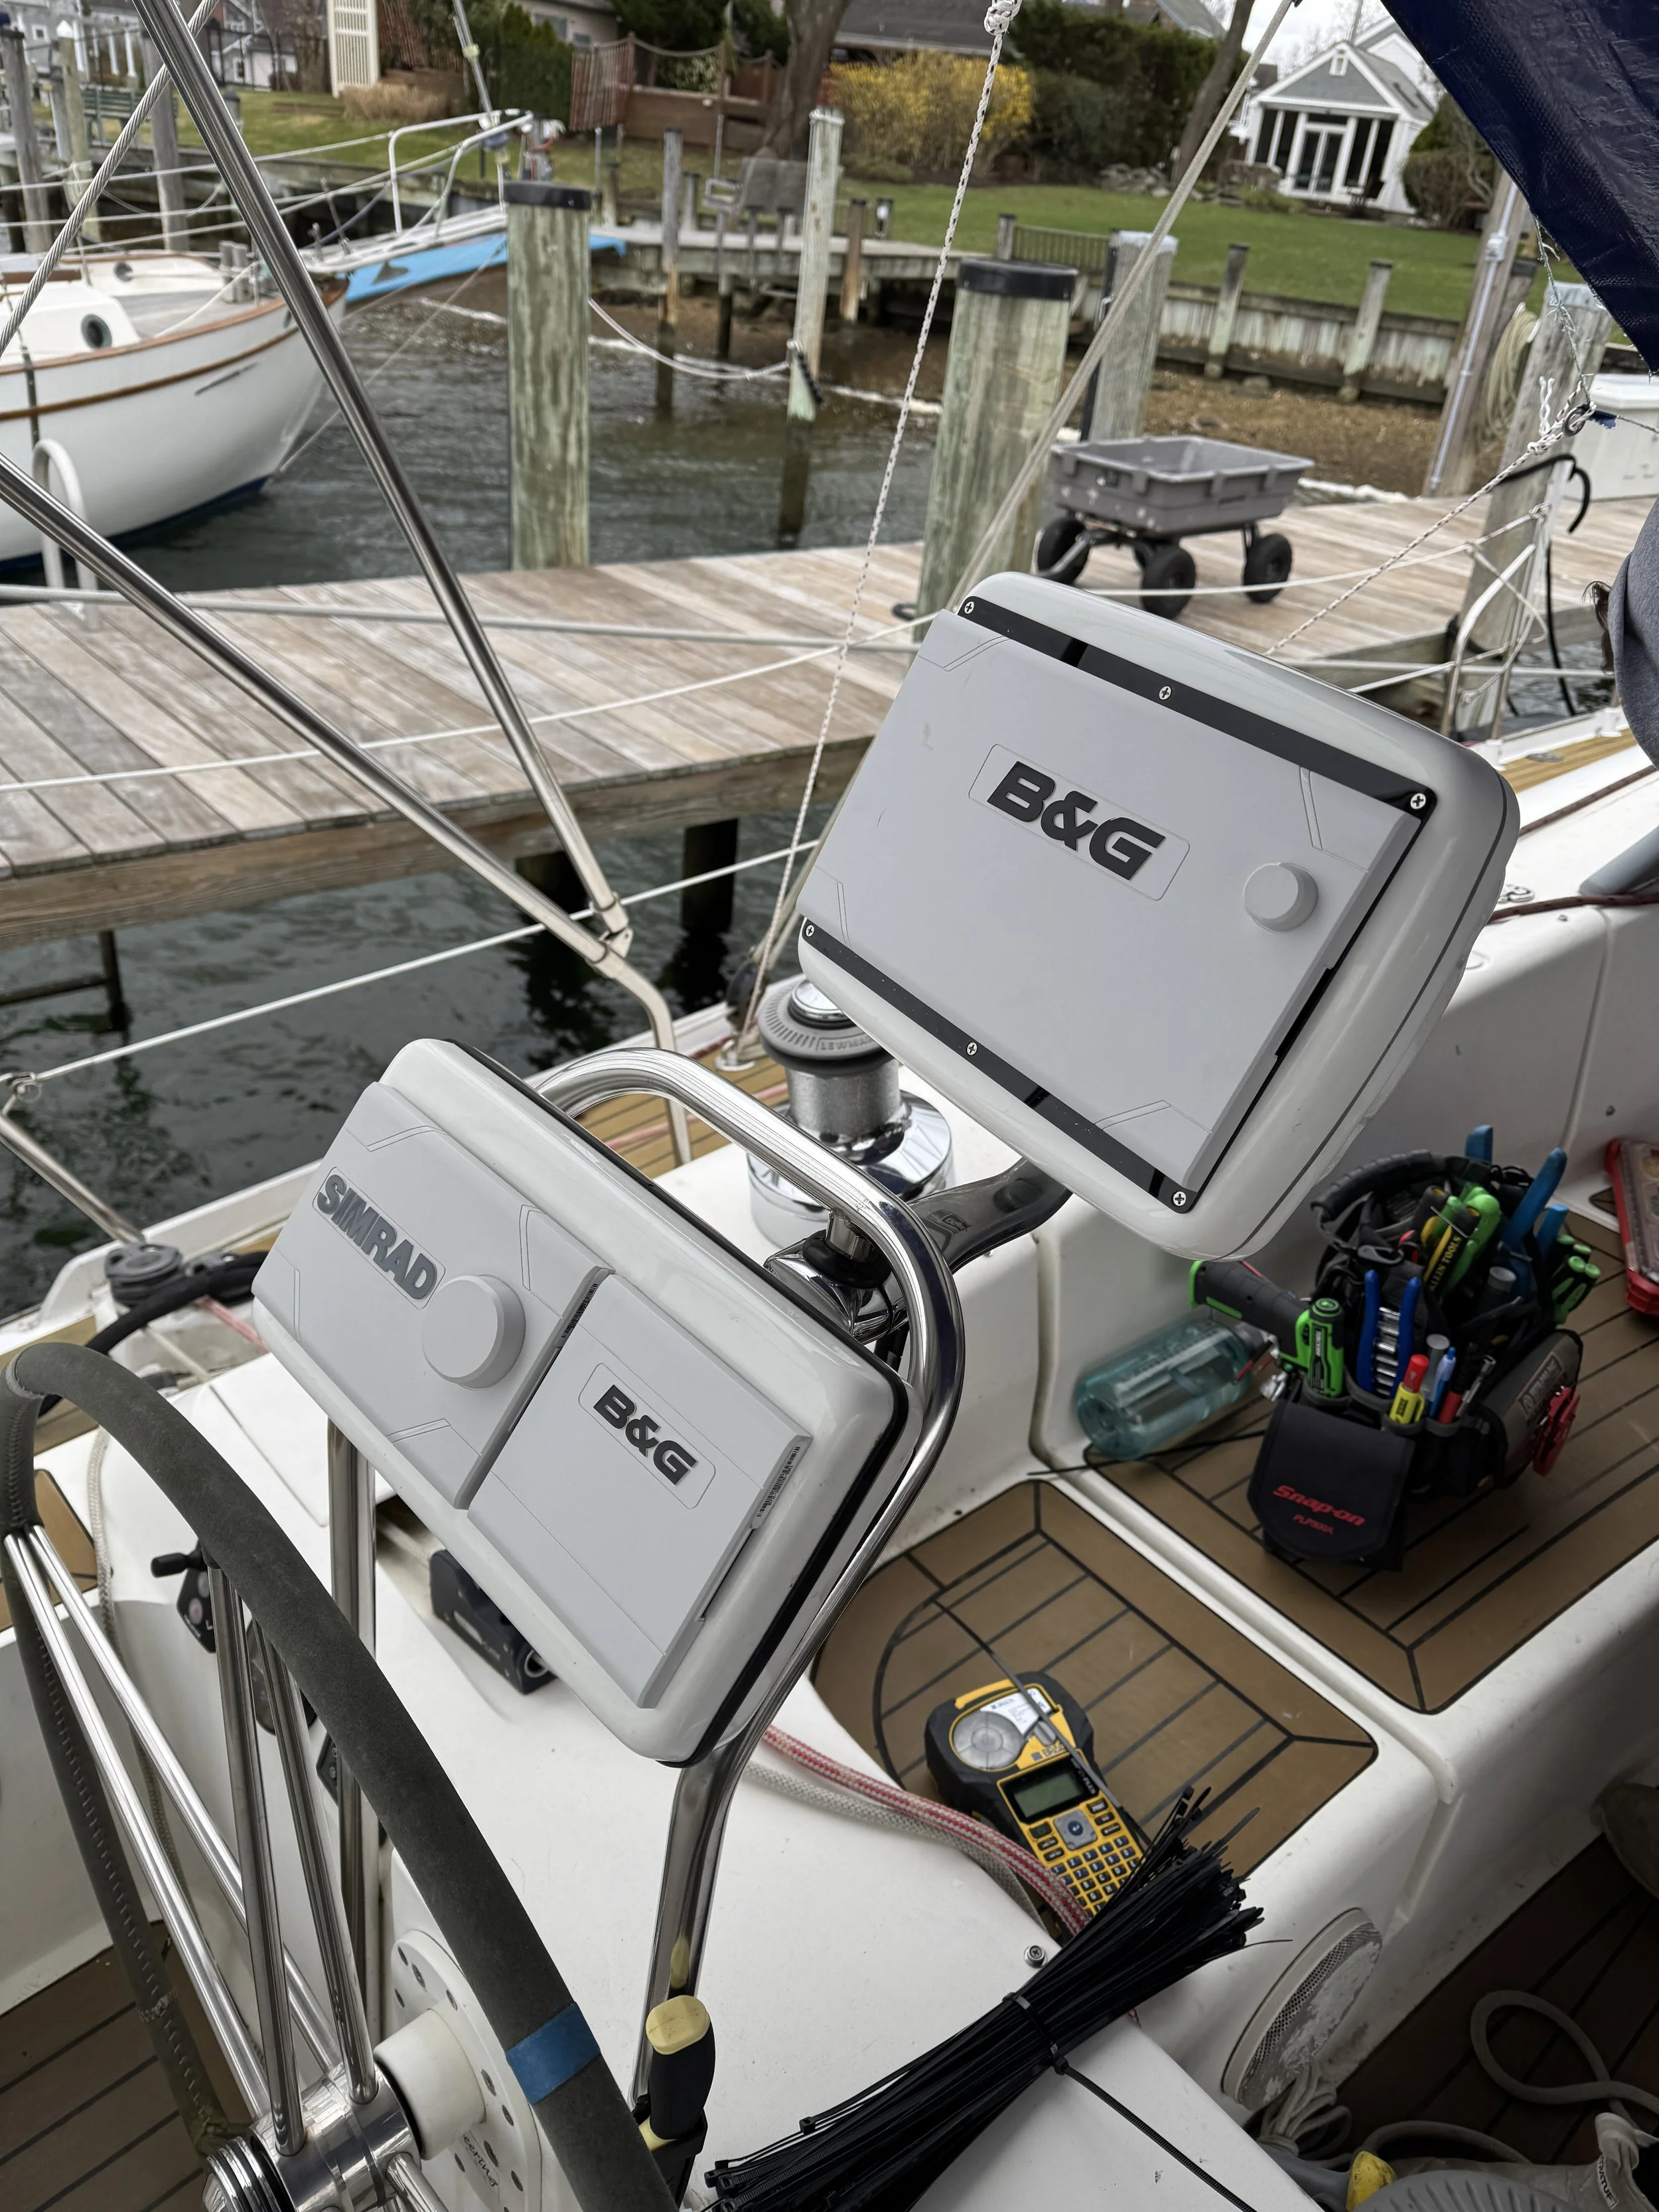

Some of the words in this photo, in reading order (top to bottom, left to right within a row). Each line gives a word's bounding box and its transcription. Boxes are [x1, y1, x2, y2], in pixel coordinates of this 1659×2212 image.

[987, 761, 1166, 881] B&G
[317, 1174, 437, 1299] SIMRAD
[1441, 1235, 1462, 1264] TOOLS
[593, 1384, 698, 1486] B&G
[1273, 1485, 1366, 1526] Snap-on
[463, 2134, 498, 2187] eering
